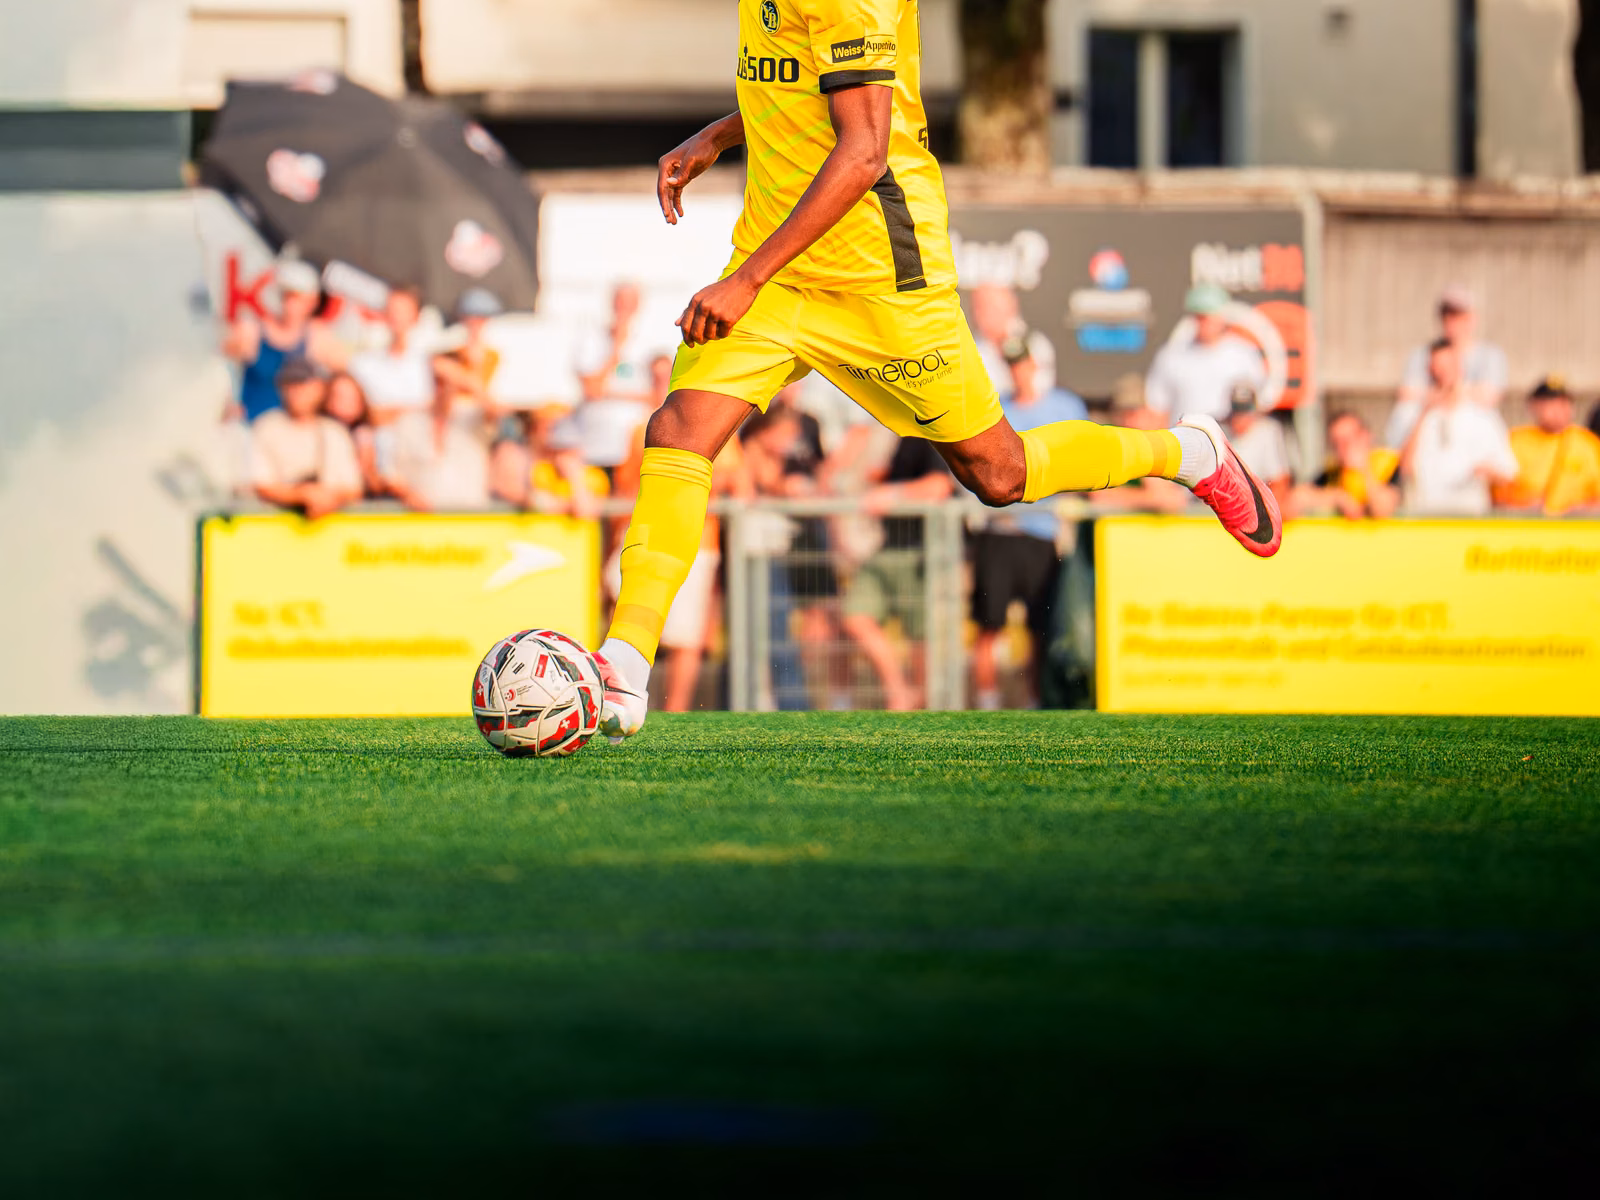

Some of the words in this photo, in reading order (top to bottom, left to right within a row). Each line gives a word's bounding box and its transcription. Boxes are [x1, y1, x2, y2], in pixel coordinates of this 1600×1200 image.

[838, 349, 949, 383] TimeTool
[917, 375, 935, 388] your
[936, 367, 952, 379] time
